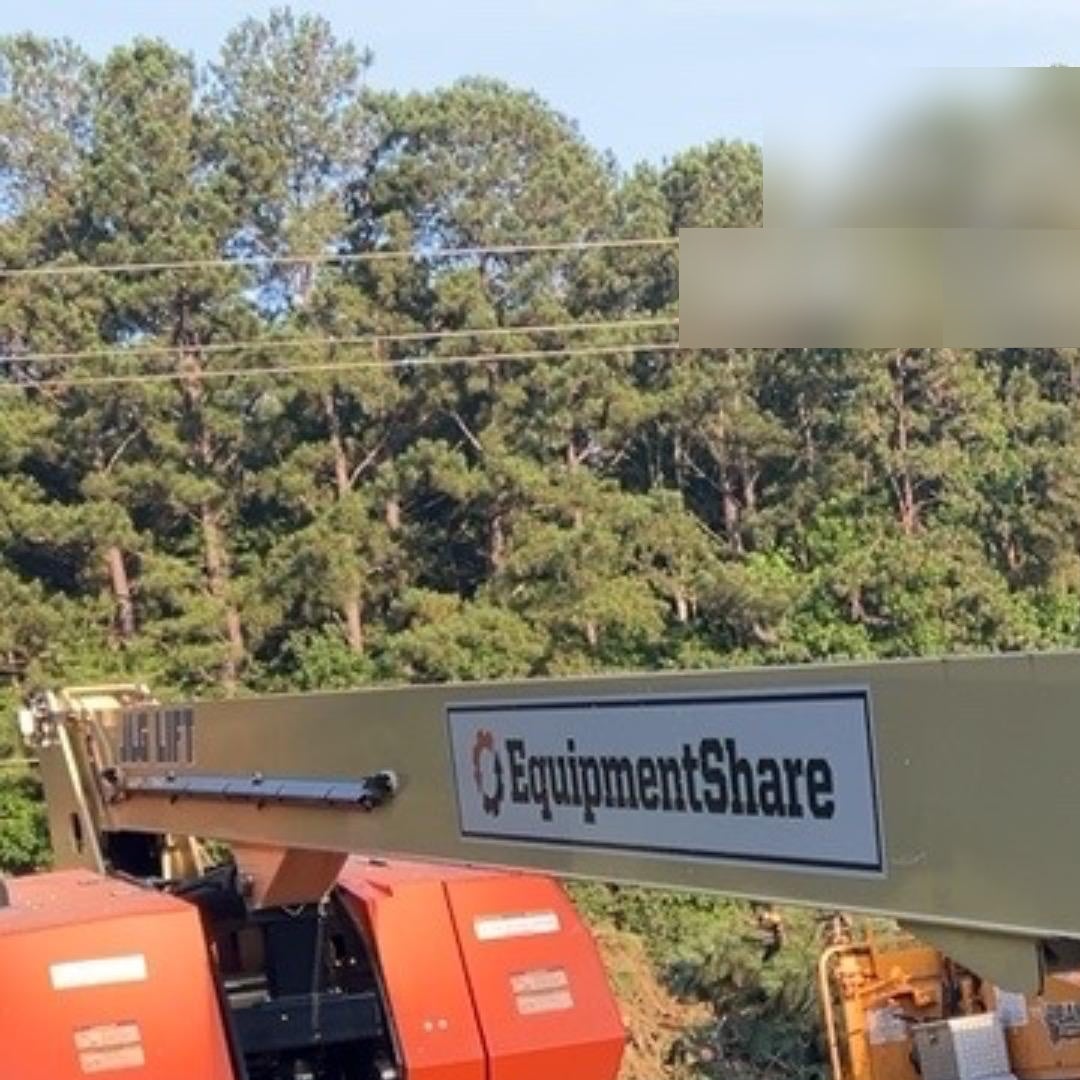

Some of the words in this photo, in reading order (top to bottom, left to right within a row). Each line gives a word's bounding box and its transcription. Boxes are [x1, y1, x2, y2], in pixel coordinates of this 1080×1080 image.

[120, 711, 148, 762] JLG
[155, 708, 193, 762] LIFT
[504, 737, 836, 824] EquipmentShare
